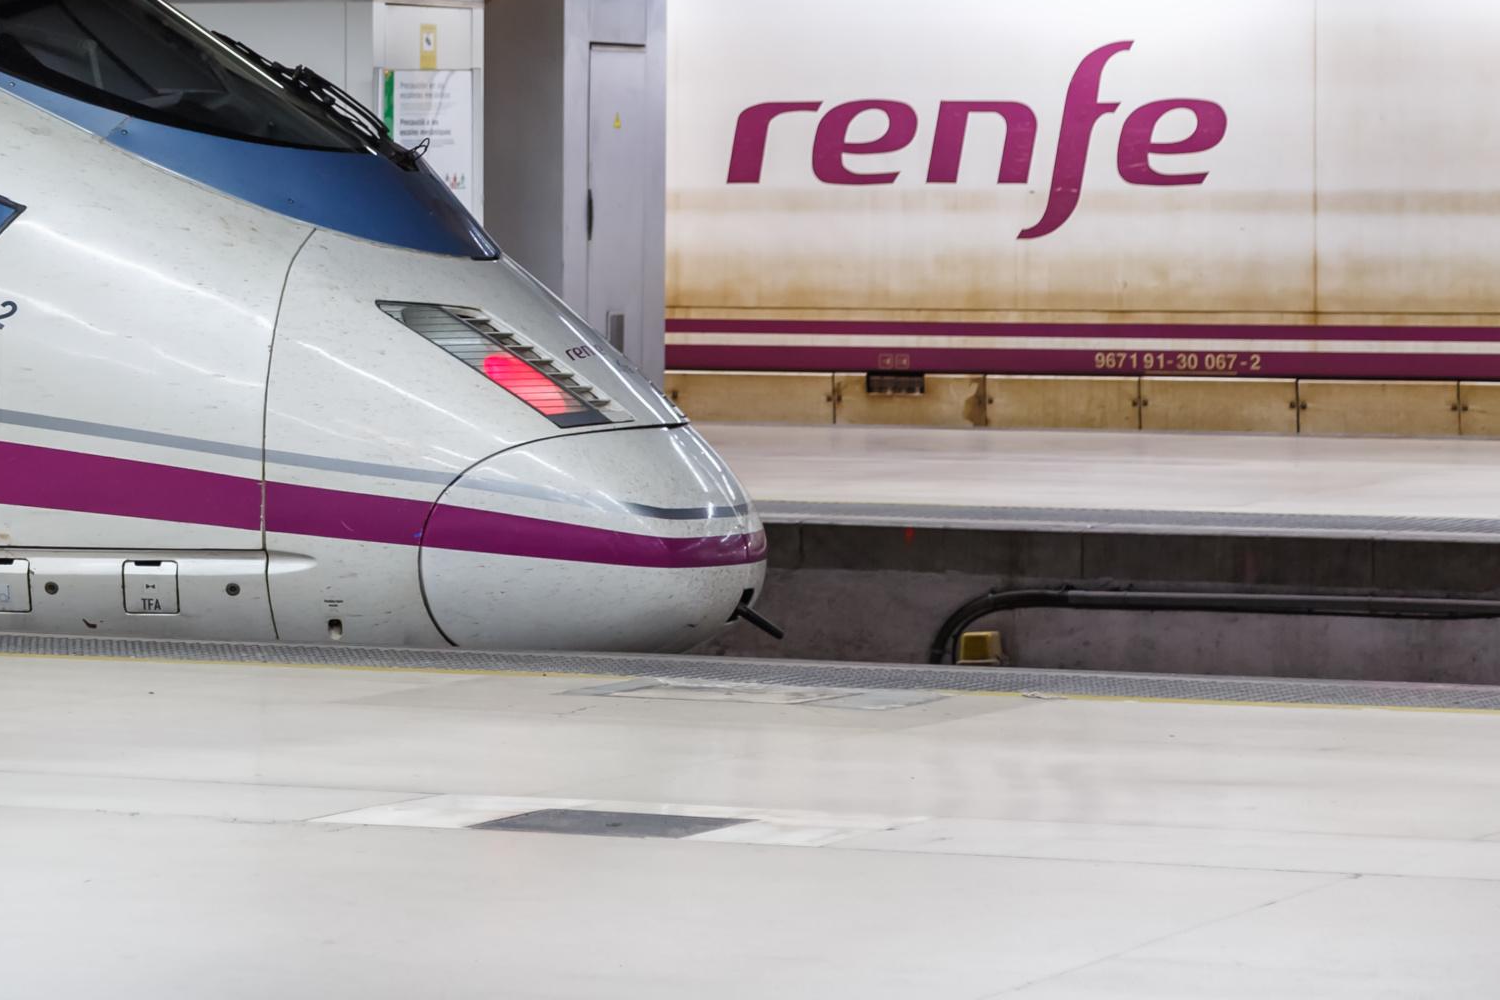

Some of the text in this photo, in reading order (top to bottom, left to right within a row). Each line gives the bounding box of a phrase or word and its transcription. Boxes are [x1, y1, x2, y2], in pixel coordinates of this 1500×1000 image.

[726, 40, 1228, 240] renfe
[1094, 352, 1138, 369] 9671
[1143, 353, 1198, 370] 91-30
[141, 598, 162, 611] TFA
